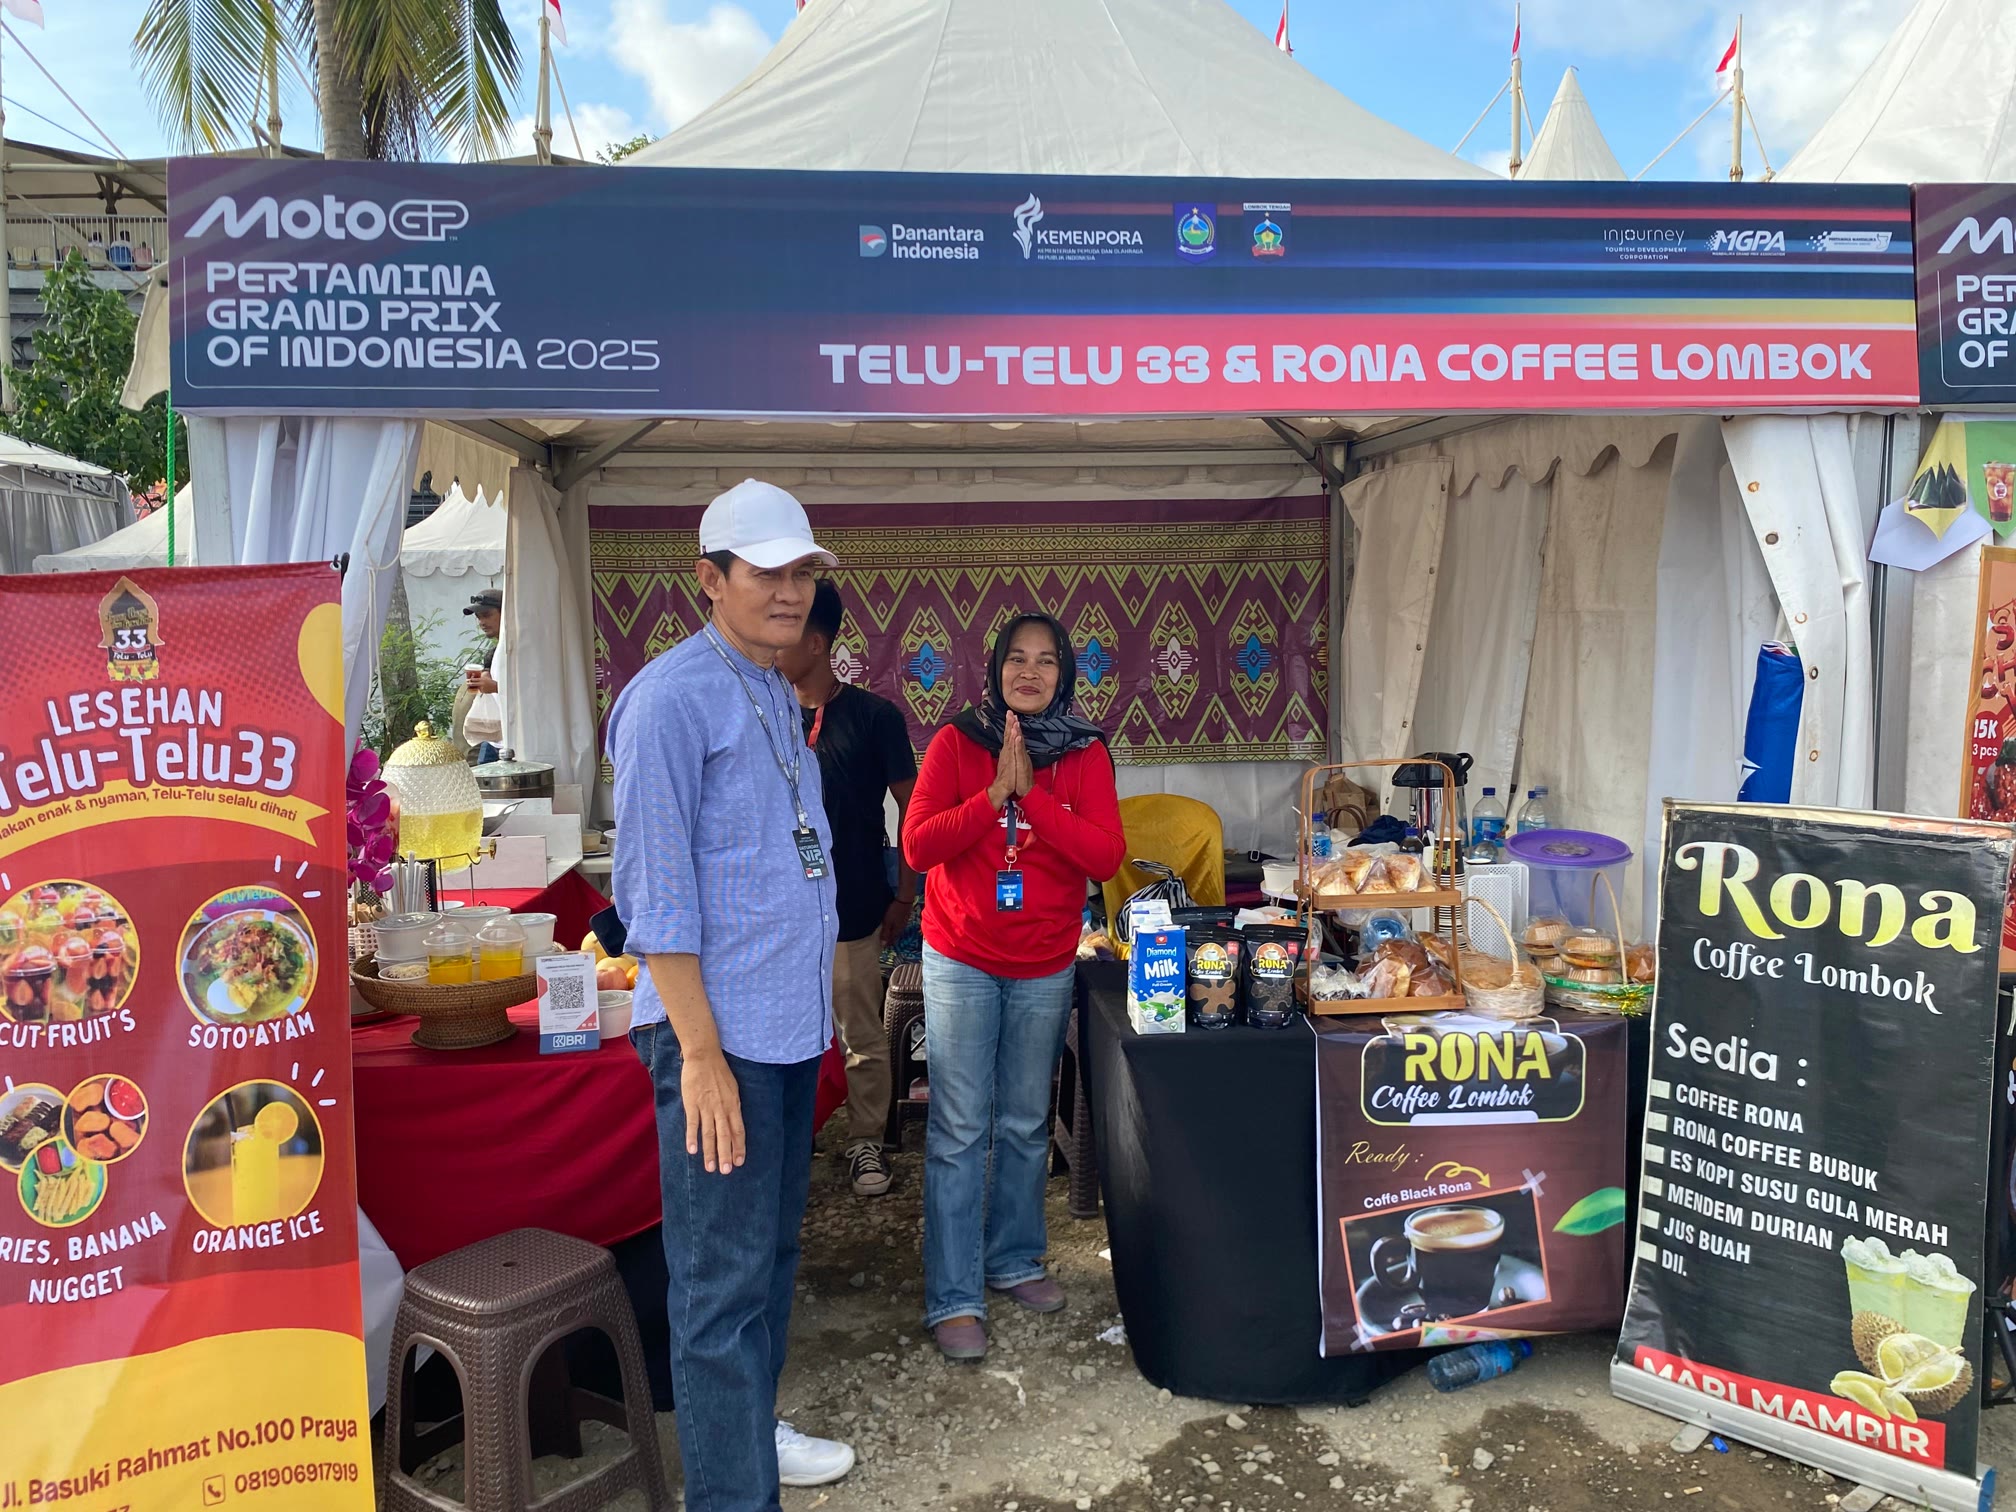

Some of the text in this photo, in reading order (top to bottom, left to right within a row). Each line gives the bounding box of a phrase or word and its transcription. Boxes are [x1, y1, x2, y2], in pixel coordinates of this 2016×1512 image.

[184, 195, 469, 241] MotoGP
[892, 224, 984, 241] Danantara
[892, 242, 979, 259] Indonesia
[1037, 230, 1143, 245] KEMENPORA
[1604, 229, 1684, 246] injourney
[1709, 230, 1785, 251] MGPA
[207, 261, 496, 296] PERTAMINA
[207, 298, 502, 332] GRAND PRIX
[1957, 308, 2016, 335] GR
[207, 335, 660, 371] OF INDONESIA 2025
[820, 343, 1872, 385] TELU-TELU 33 & RONA COFFEE LOMBOK
[1959, 340, 2008, 368] OF
[115, 630, 147, 649] 33
[48, 687, 222, 736] LESEHAN
[1973, 718, 1999, 740] 15K
[1972, 743, 1998, 760] 3 pcs
[0, 788, 298, 840] akan enak & nyaman, Telu-Telu selalu dihati
[800, 849, 822, 861] VIP
[1674, 841, 1982, 954] Rona
[1144, 958, 1180, 980] Milk
[1147, 946, 1177, 957] Diamond
[1197, 959, 1226, 970] RONA
[1259, 958, 1288, 969] RONA
[1693, 937, 1943, 1015] Coffee Lombok
[0, 1009, 136, 1048] CUT FRUIT'S
[188, 1011, 315, 1049] SOTO AYAM
[566, 1034, 586, 1046] BRI
[1404, 1031, 1551, 1082] RONA
[1665, 1022, 1778, 1082] Sedia
[1372, 1083, 1535, 1114] Coffee Lombok
[1675, 1083, 1804, 1134] COFFEE RONA
[1345, 1141, 1410, 1172] Ready
[1673, 1116, 1878, 1192] RONA COFFEE BUBUK
[1363, 1181, 1472, 1209] Coffe Black Rona
[1670, 1150, 1948, 1247] ES KOPI SUSU GULA MERAH
[193, 1210, 324, 1253] ORANGE ICE
[1667, 1182, 1833, 1251] MENDEM DURIAN
[68, 1211, 167, 1261] BANANA
[1663, 1217, 1750, 1265] JUS BUAH
[28, 1266, 123, 1303] NUGGET
[1751, 1389, 1930, 1458] MAMPIR
[29, 1463, 111, 1505] Basuki
[117, 1436, 211, 1482] Rahmat
[217, 1418, 295, 1453] No.100
[300, 1416, 357, 1442] Praya
[234, 1462, 358, 1494] 081906917919
